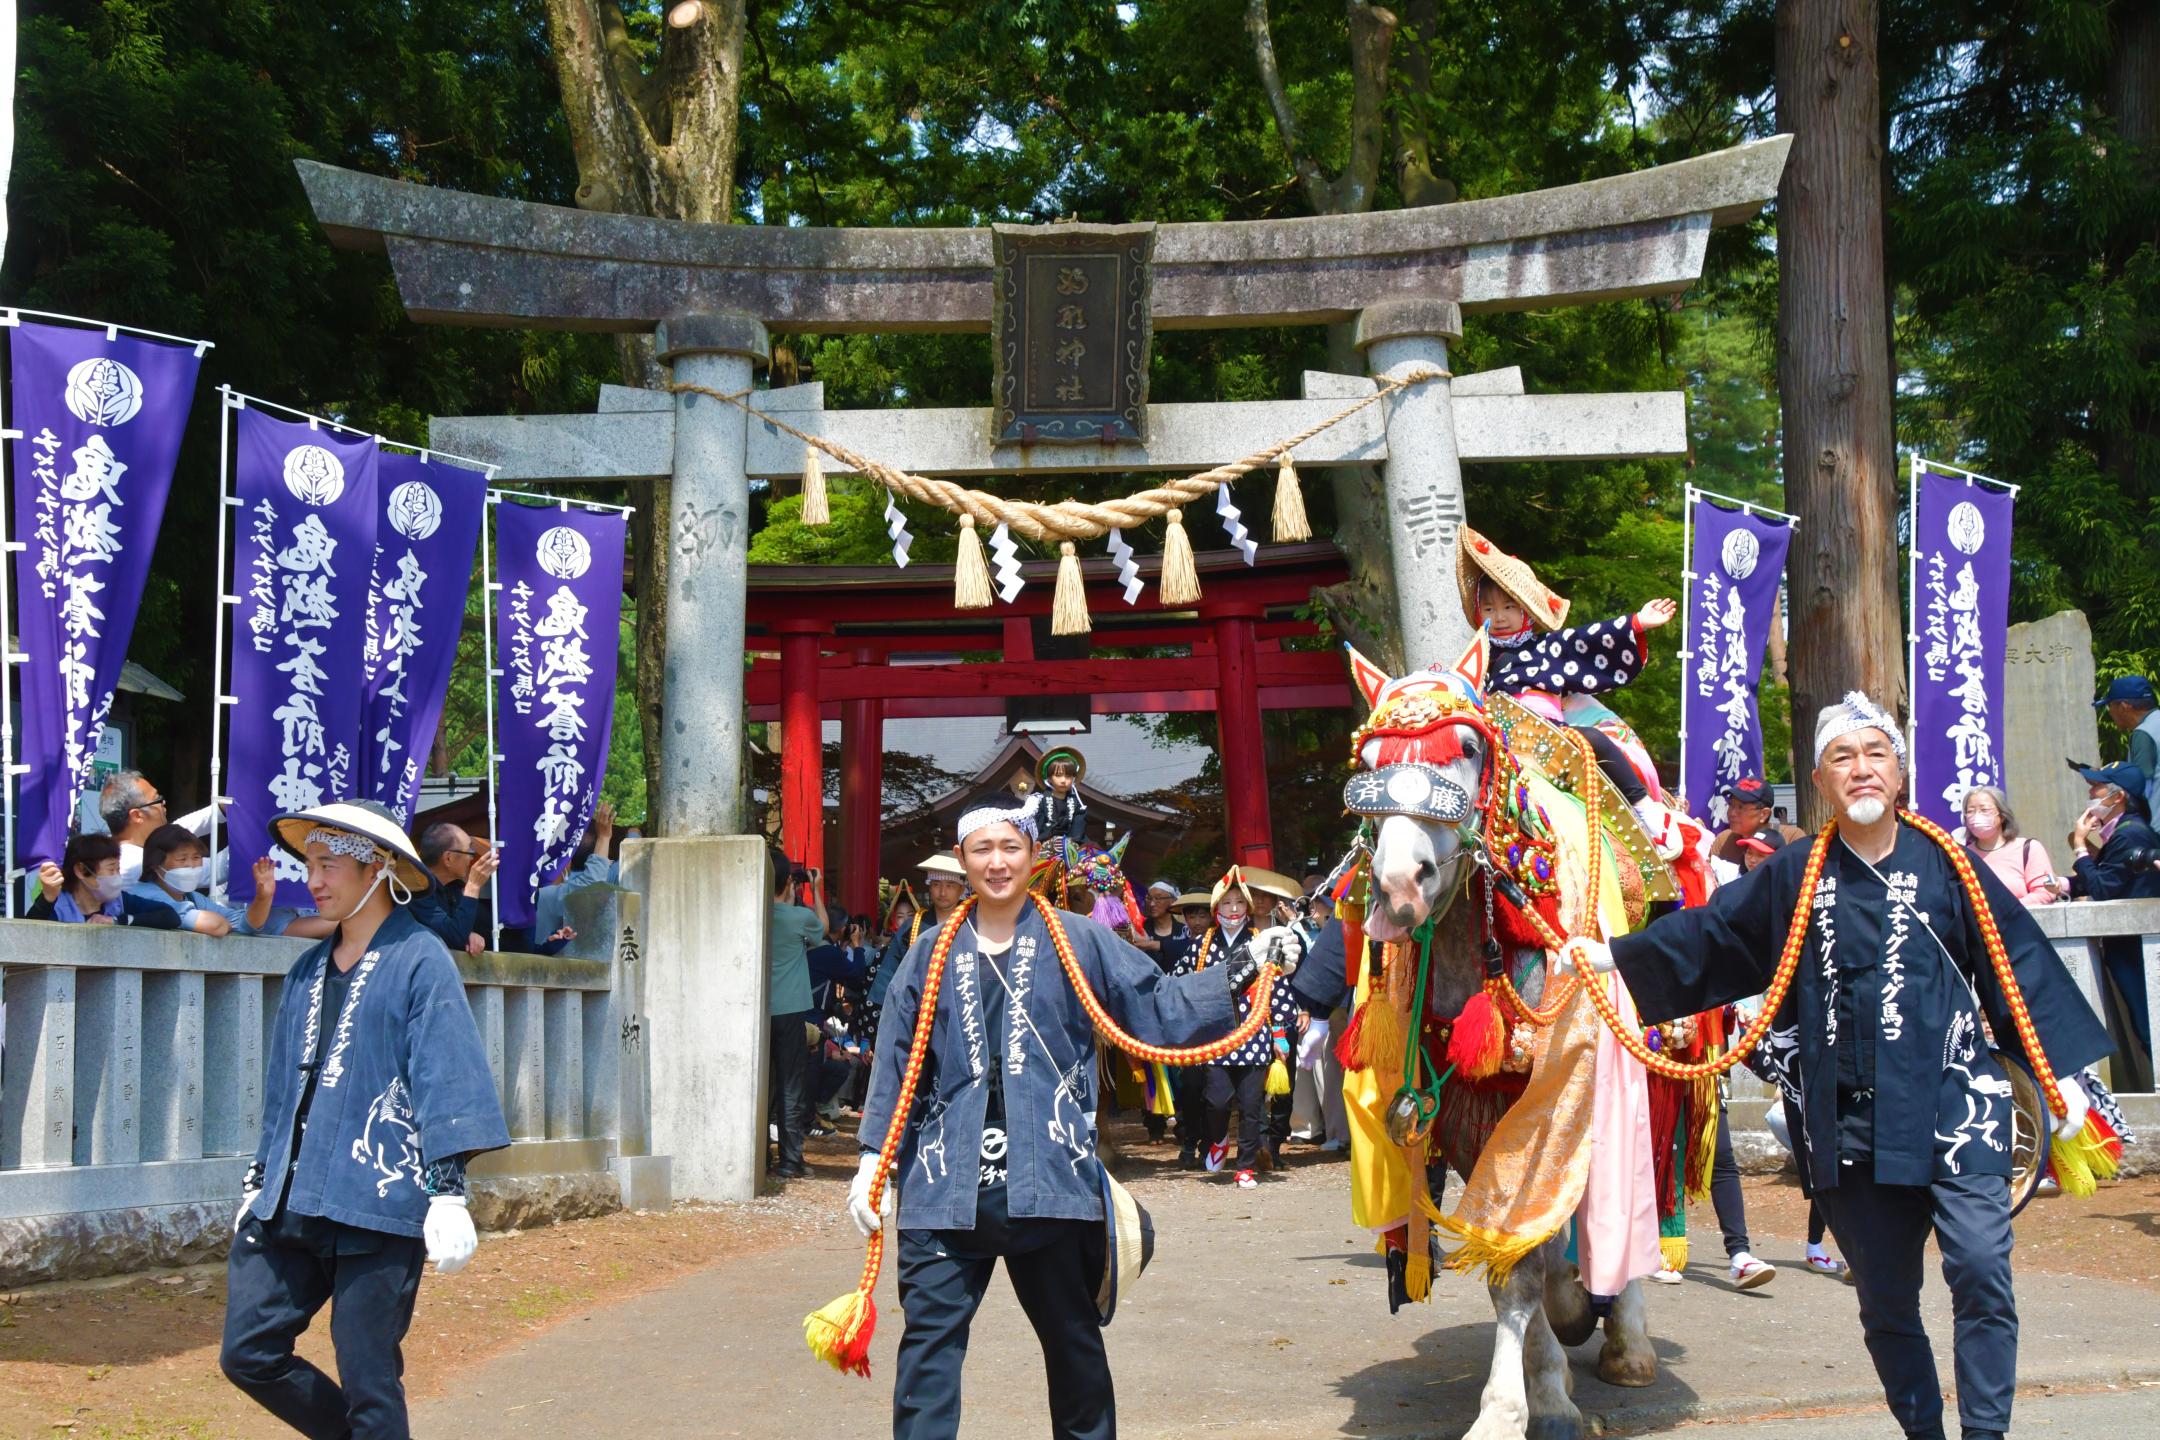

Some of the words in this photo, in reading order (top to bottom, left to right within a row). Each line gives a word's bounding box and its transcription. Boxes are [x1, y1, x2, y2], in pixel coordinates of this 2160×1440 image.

[321, 971, 367, 1088] チャグチャグ馬コ
[1007, 957, 1032, 1075] チャグチャグ馬コ
[1880, 903, 1911, 1042] チャグチャグ馬コ
